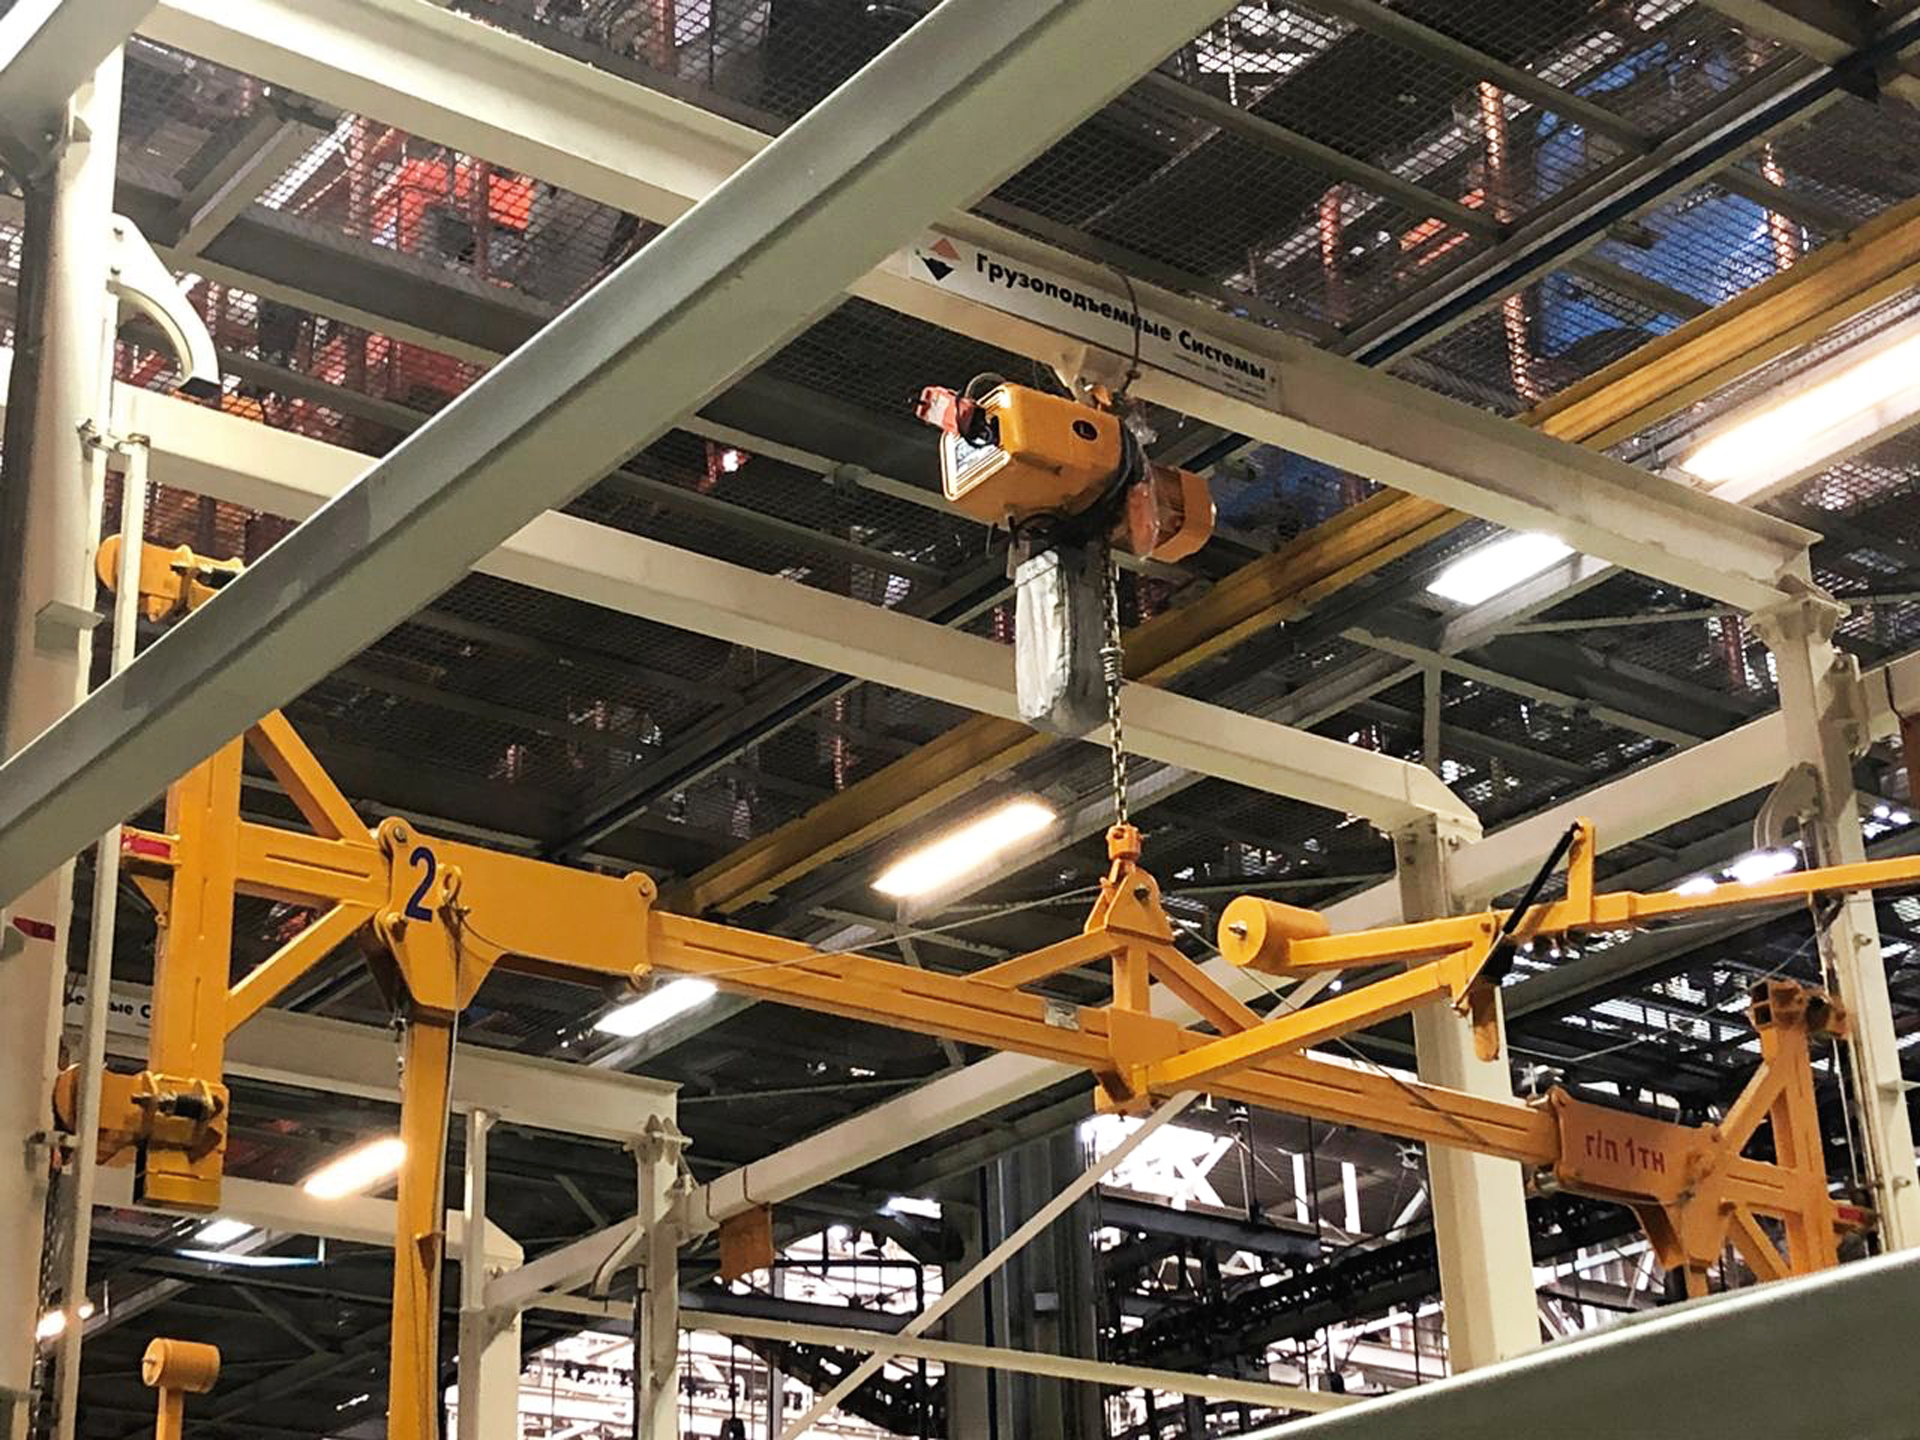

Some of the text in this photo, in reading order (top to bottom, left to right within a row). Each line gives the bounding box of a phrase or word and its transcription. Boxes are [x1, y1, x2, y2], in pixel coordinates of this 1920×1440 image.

[976, 253, 1172, 341] Грузоподъемные
[1178, 330, 1266, 381] Системы
[405, 846, 436, 923] 2
